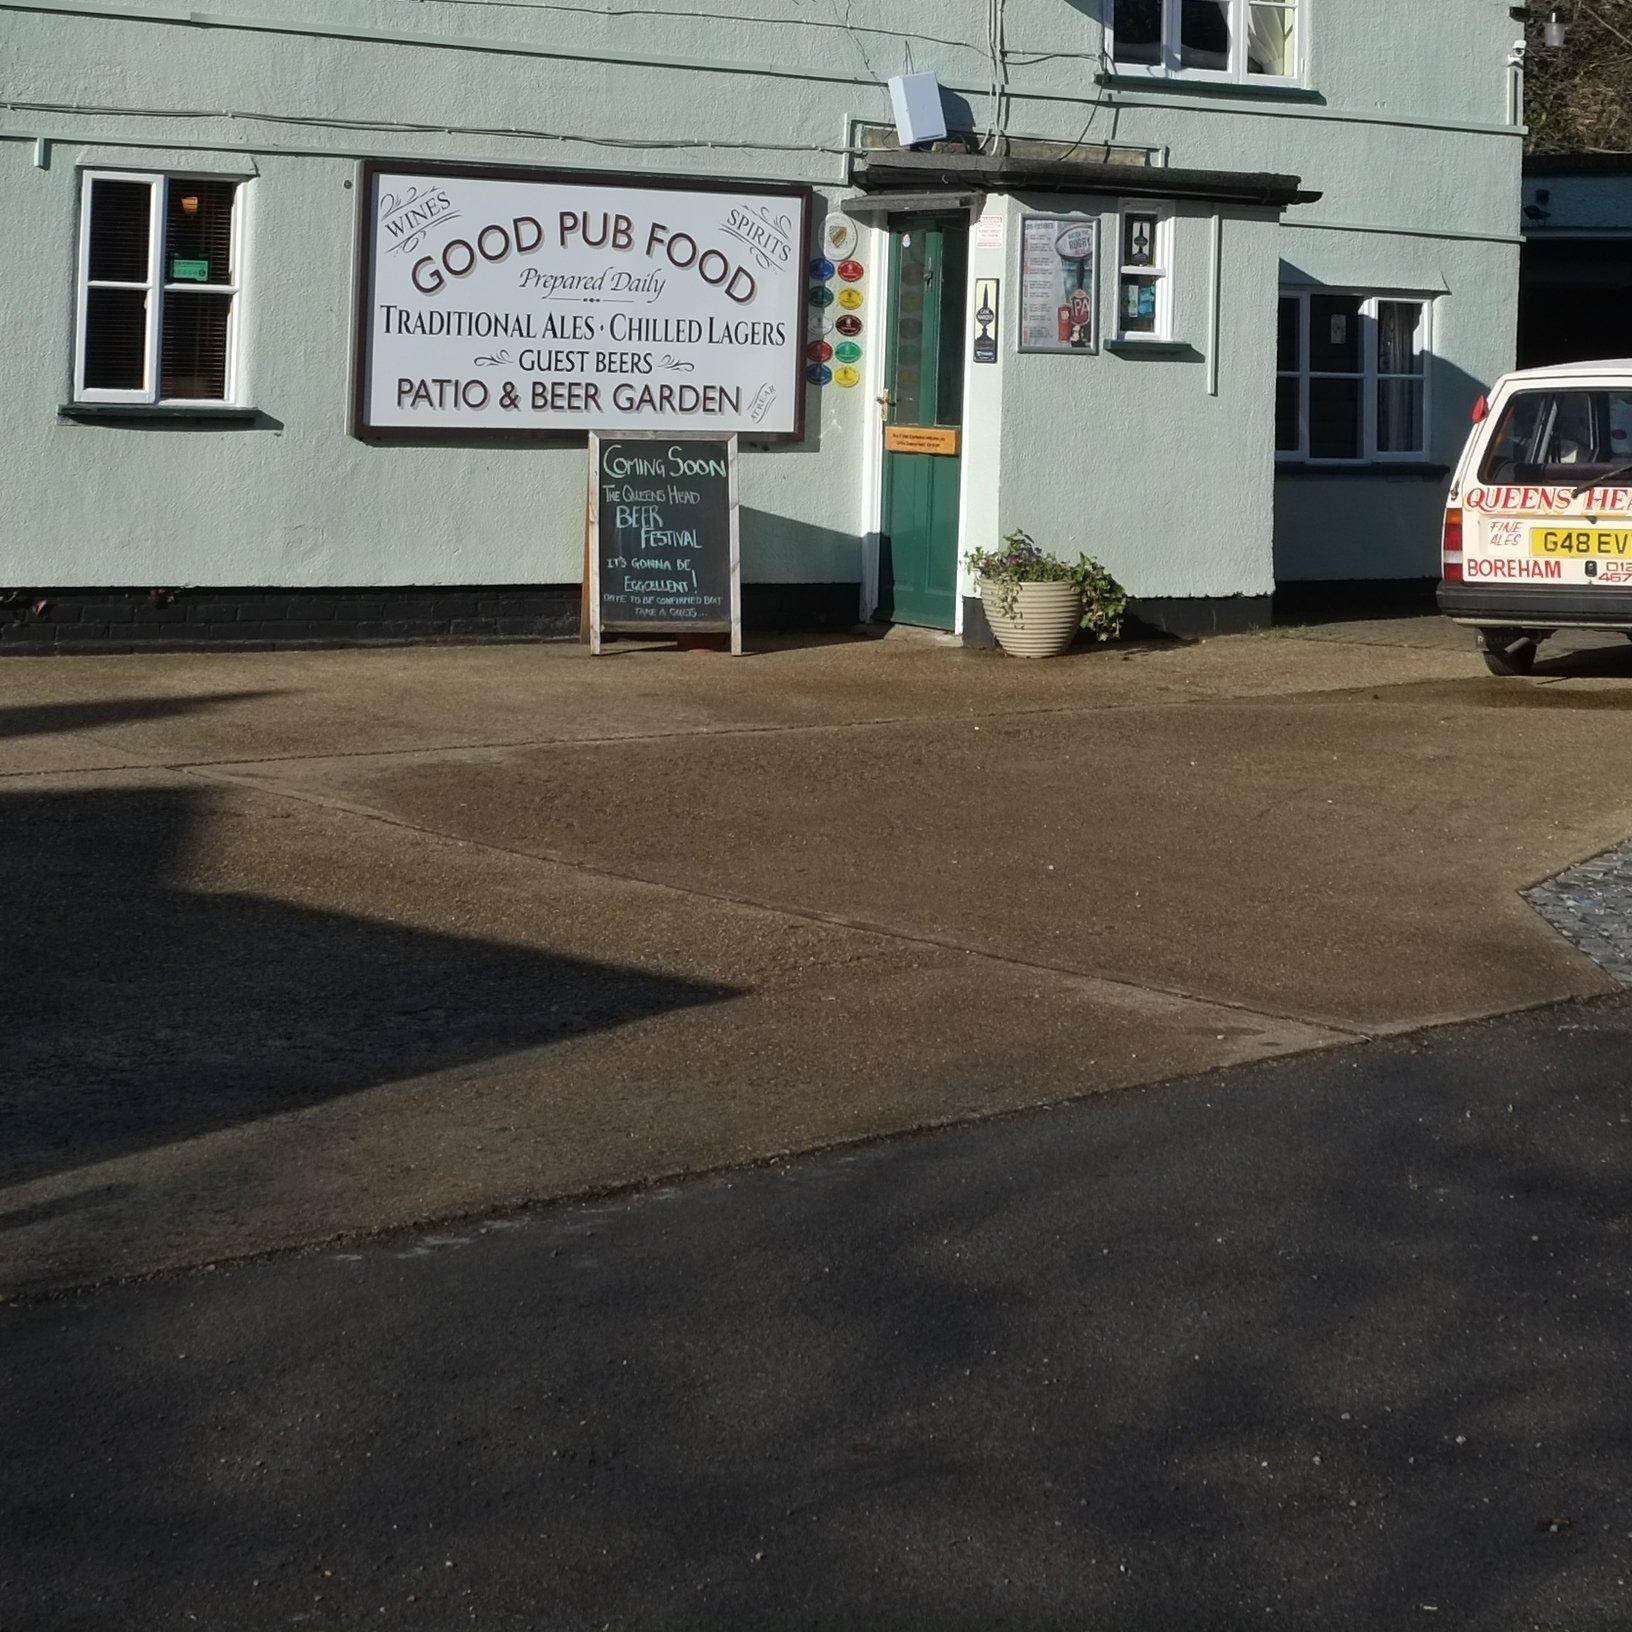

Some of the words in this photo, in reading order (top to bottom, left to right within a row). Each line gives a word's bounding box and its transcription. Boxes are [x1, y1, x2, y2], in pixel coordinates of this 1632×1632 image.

[383, 191, 452, 240] WINES
[726, 208, 793, 263] SPIRITS
[410, 216, 544, 295] GOOD
[558, 210, 635, 250] PUB
[645, 222, 758, 305] FOOD
[519, 267, 607, 299] Prepared
[610, 268, 667, 304] Daily
[379, 305, 536, 339] TRADITIONAL
[541, 311, 596, 341] ALES
[609, 313, 703, 344] CHILLED
[707, 317, 787, 347] LAGERS
[518, 349, 589, 373] GUEST
[594, 352, 653, 374] BEERS
[396, 378, 490, 410] PATIO
[498, 381, 521, 411] &
[531, 383, 603, 413] BEER
[612, 383, 743, 415] GARDEN
[603, 444, 666, 478] COMING
[668, 445, 727, 478] SOON
[602, 484, 621, 503] THE
[667, 484, 701, 505] HEAD
[616, 505, 664, 529] BEER
[1490, 521, 1524, 533] FINE
[641, 528, 703, 549] FESTIVAL
[1489, 534, 1522, 546] ALES
[1543, 532, 1590, 553] G48
[631, 557, 672, 571] GONNA
[676, 558, 692, 571] BE
[1468, 558, 1562, 578] BOREHAM
[630, 595, 642, 604] TO
[643, 596, 655, 604] BE
[659, 608, 667, 616] A
